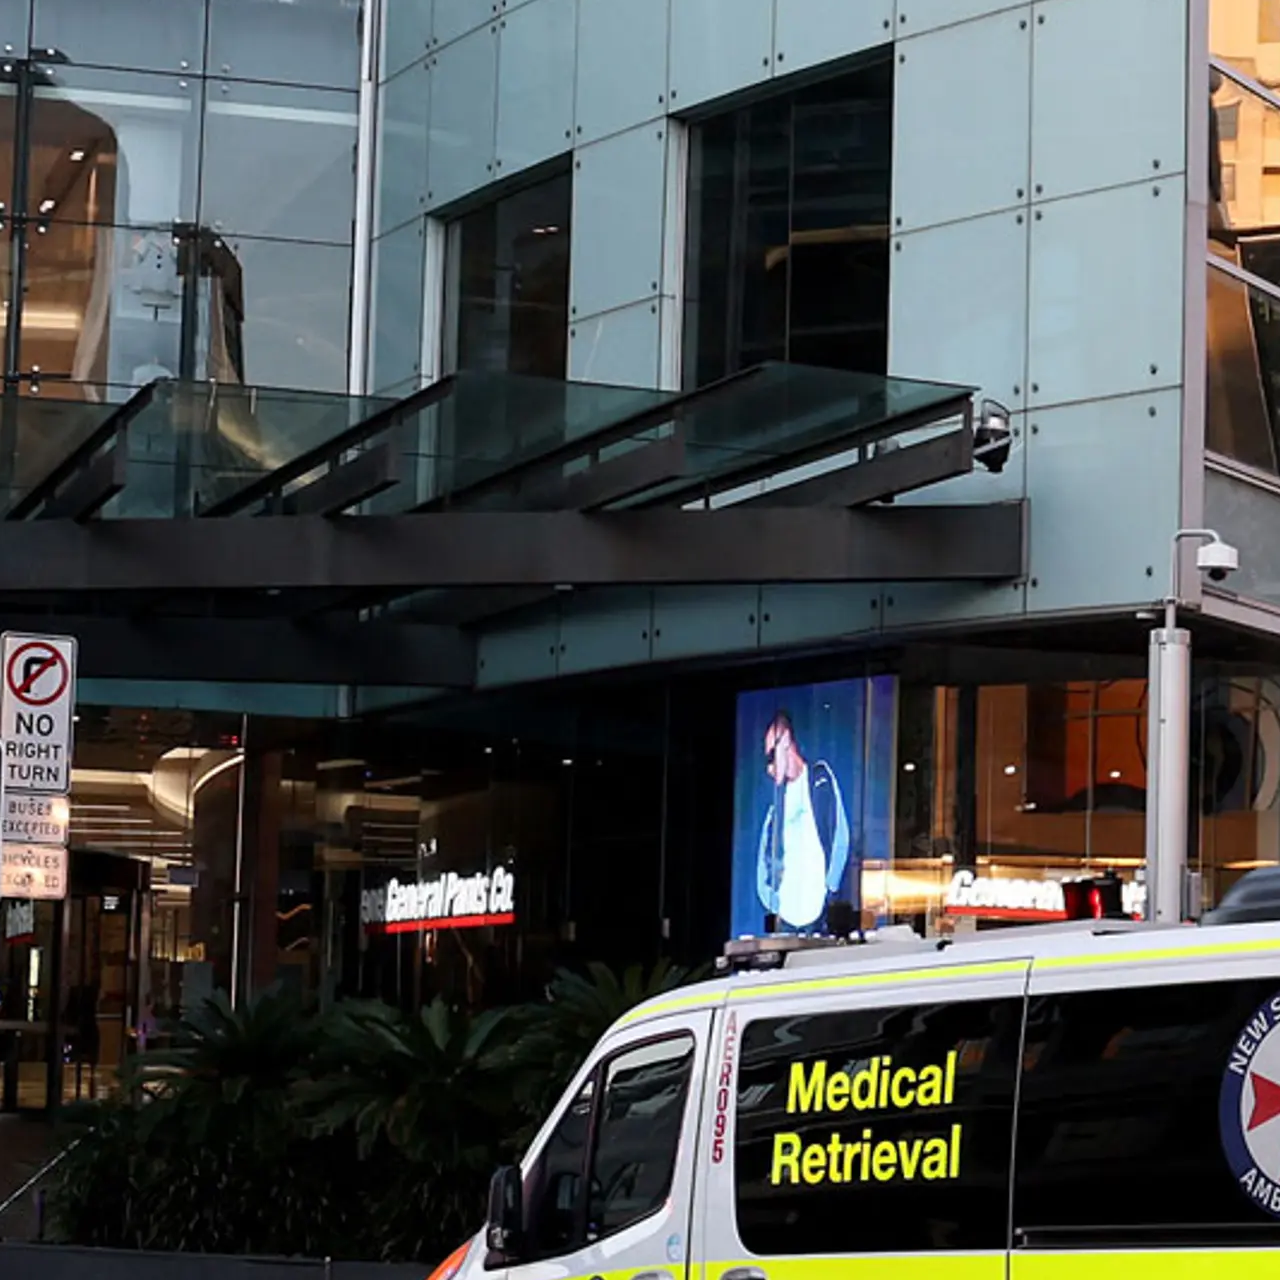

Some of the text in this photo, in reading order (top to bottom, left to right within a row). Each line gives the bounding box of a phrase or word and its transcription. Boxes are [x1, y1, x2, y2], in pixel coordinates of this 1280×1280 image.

[15, 712, 54, 737] NO
[6, 740, 62, 761] RIGHT
[7, 764, 61, 783] TURN
[3, 819, 61, 836] EXCEPTED
[384, 871, 446, 923] General
[443, 871, 490, 917] Pants
[1228, 1011, 1269, 1076] NEW
[785, 1050, 958, 1114] Medical
[771, 1123, 963, 1186] Retrieval
